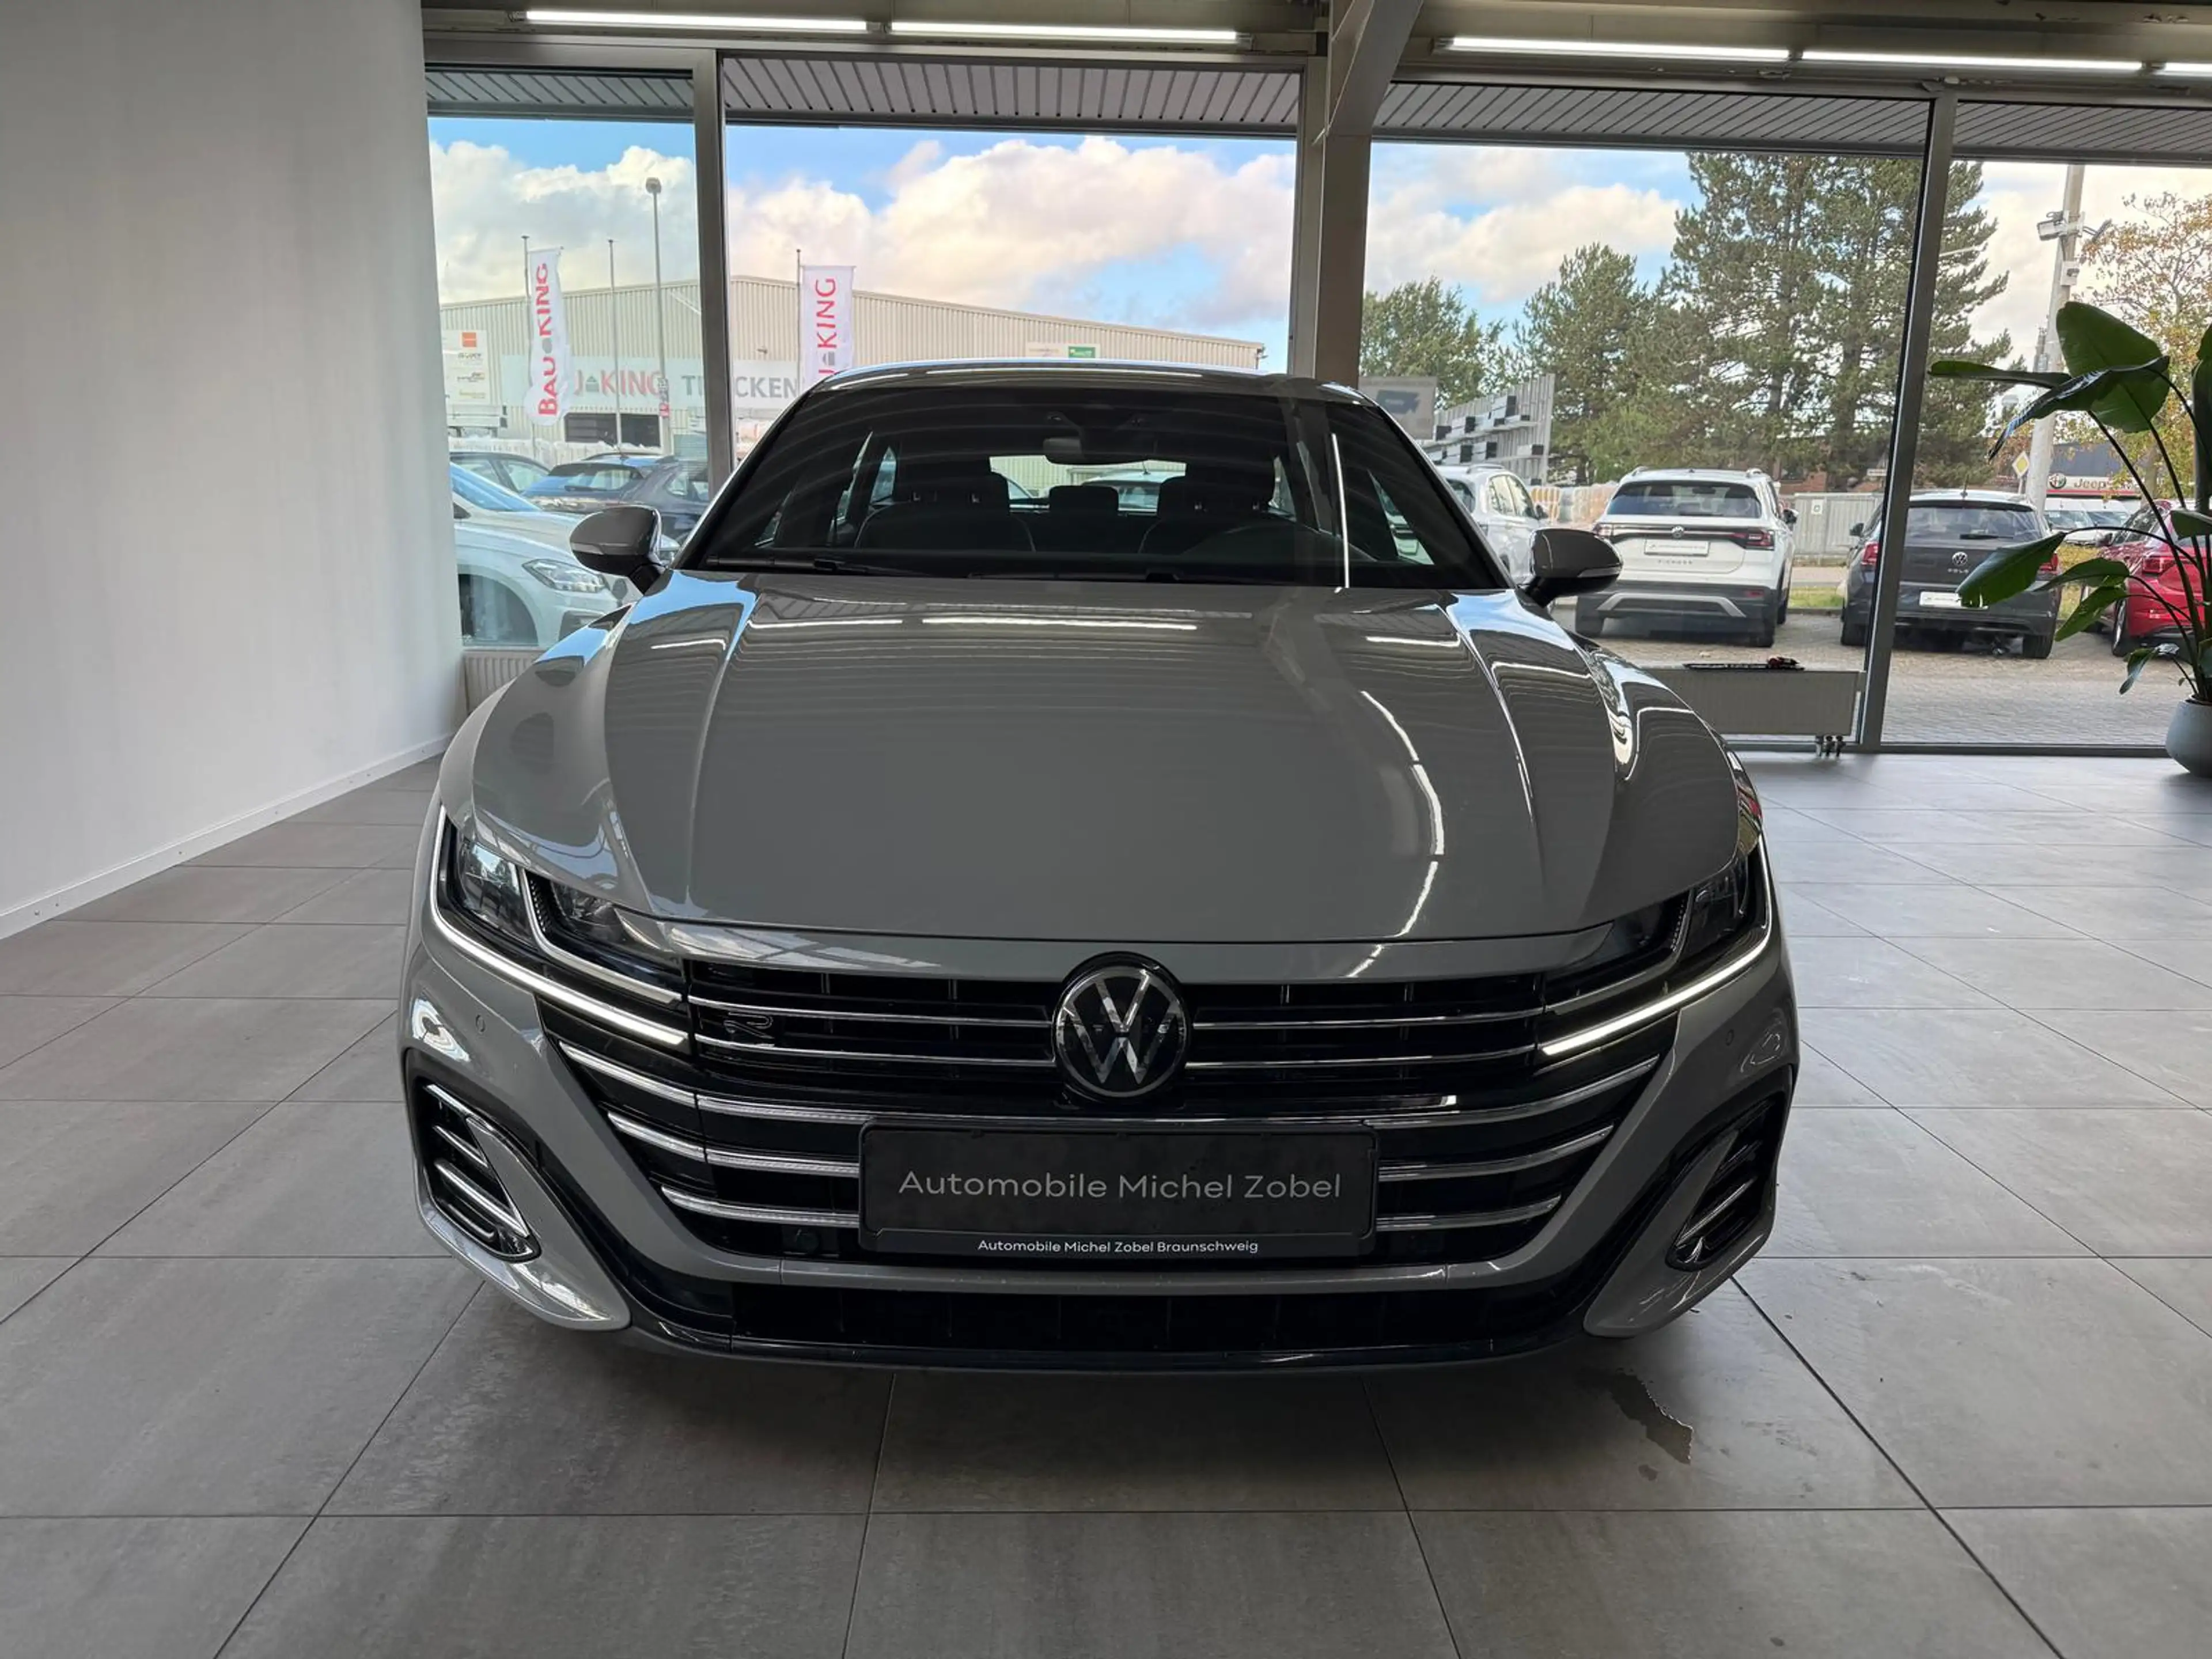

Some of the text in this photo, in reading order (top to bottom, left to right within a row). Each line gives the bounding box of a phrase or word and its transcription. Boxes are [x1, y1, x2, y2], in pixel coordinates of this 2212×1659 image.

[816, 279, 837, 349] KING
[536, 263, 558, 417] BAU KING
[899, 1171, 1340, 1198] Automobile Michel Zobel
[978, 1240, 1258, 1253] Automobile Michel Zobel Braunschweig
